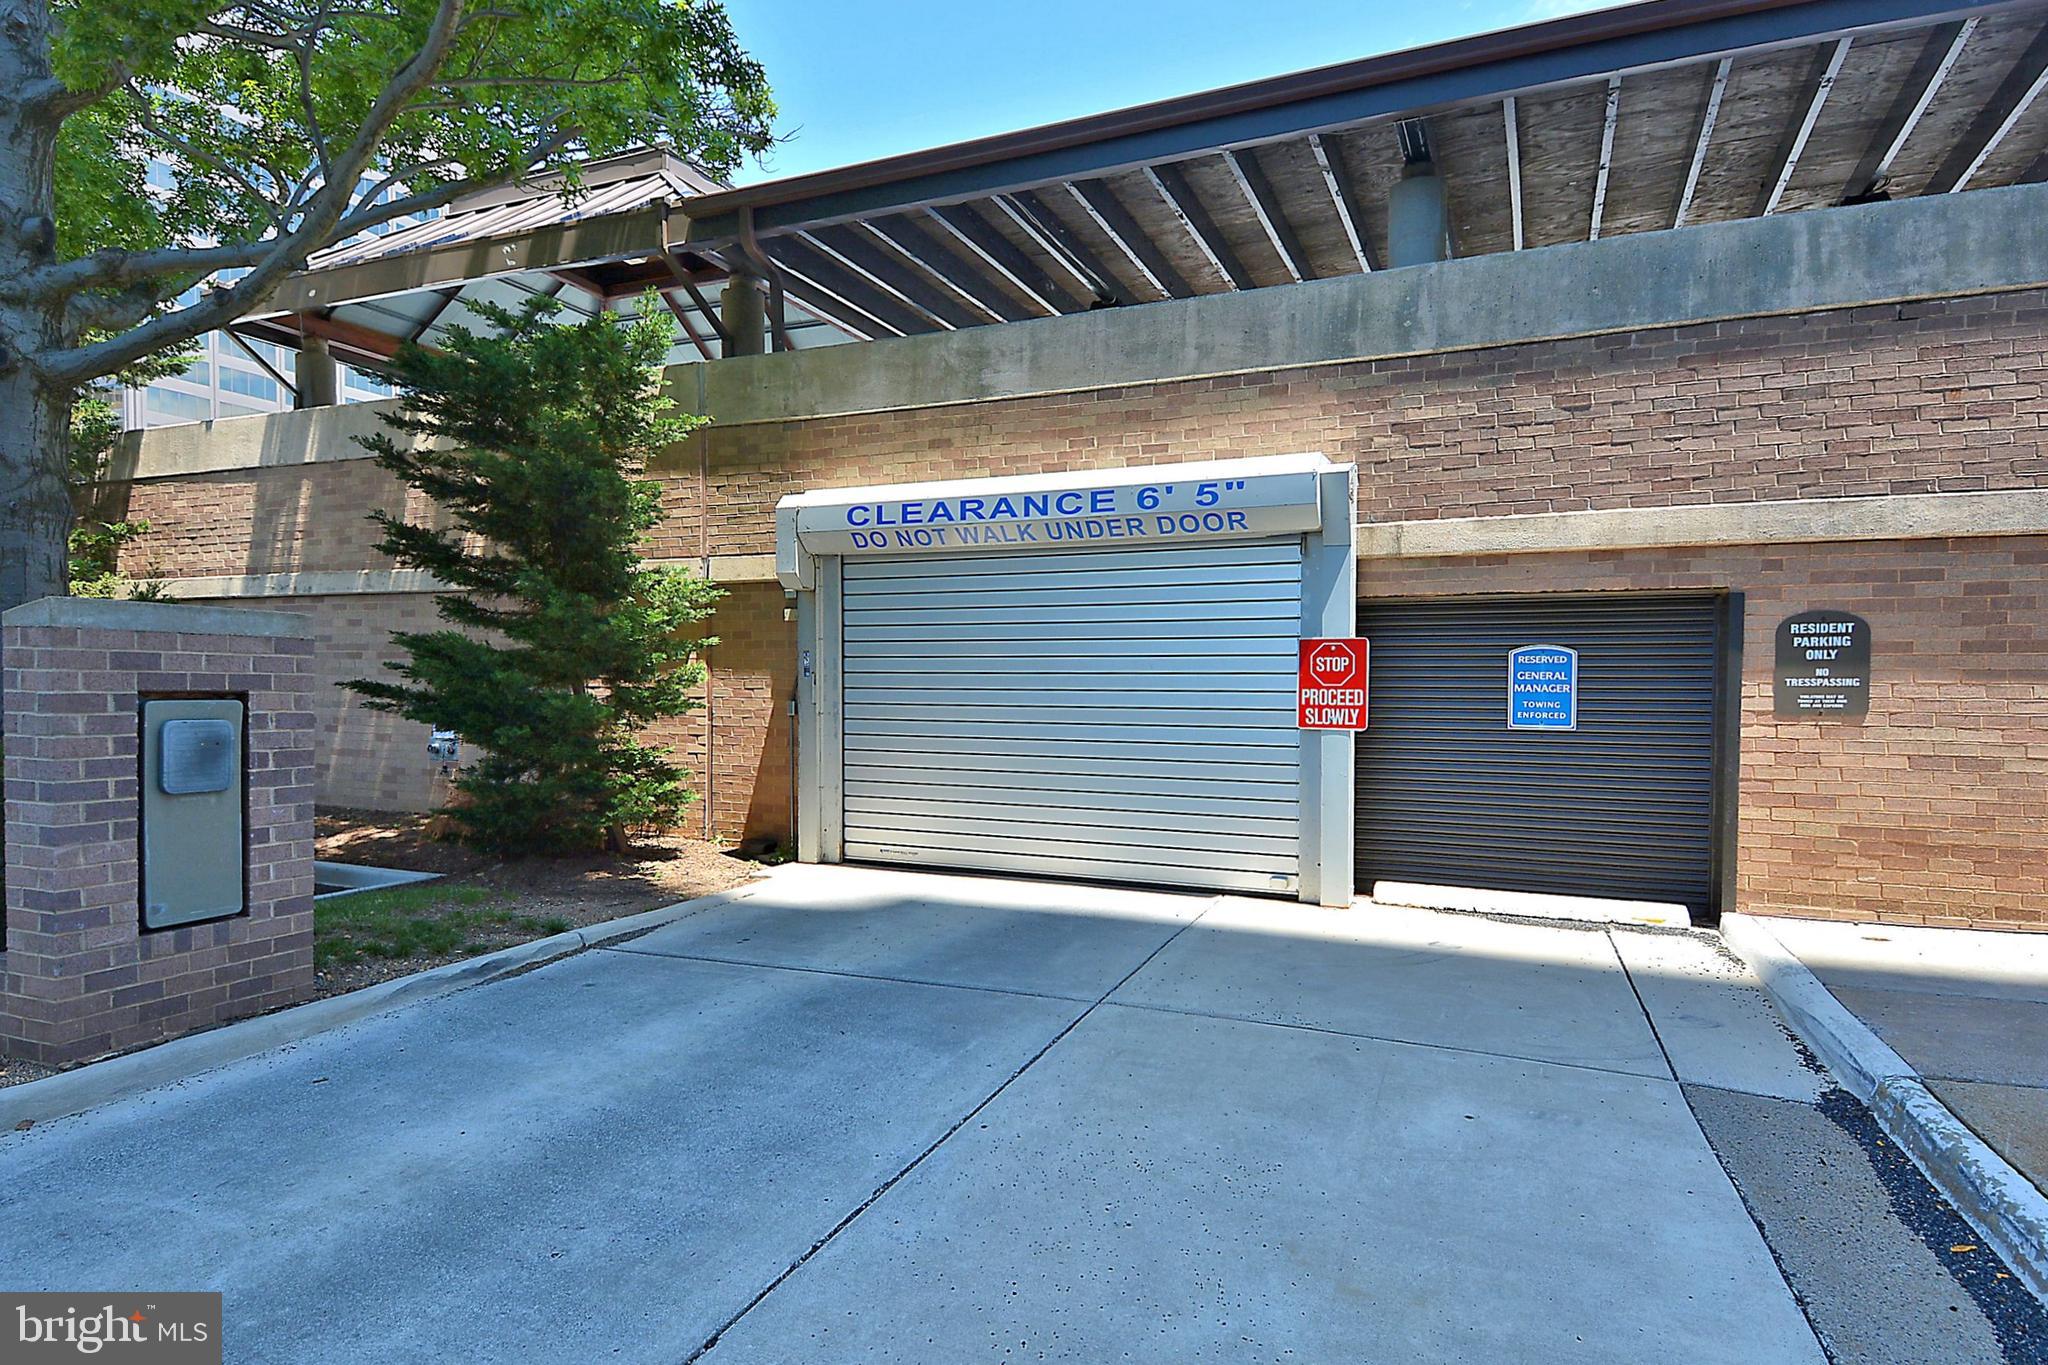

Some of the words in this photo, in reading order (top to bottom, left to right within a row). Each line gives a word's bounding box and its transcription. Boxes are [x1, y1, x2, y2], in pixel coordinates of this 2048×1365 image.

[847, 489, 1116, 527] CLEARANCE
[1136, 485, 1174, 511] 6'
[851, 531, 888, 549] DO
[895, 528, 946, 547] NOT
[955, 523, 1037, 544] WALK
[1045, 517, 1147, 540] UNDER
[1156, 511, 1249, 534] DOOR
[1790, 623, 1855, 634] RESIDENT
[1793, 636, 1852, 647] PARKING
[1518, 655, 1568, 664] RESERVED
[1805, 649, 1838, 660] ONLY
[1316, 657, 1350, 672] STOP
[1517, 671, 1569, 680] GENERAL
[1815, 668, 1830, 677] NO
[1784, 678, 1861, 687] TRESSPASSING
[1514, 684, 1571, 693] MANAGER
[1301, 688, 1364, 706] PROCEED
[1305, 707, 1360, 725] SLOWLY
[1517, 711, 1567, 719] ENFORCED
